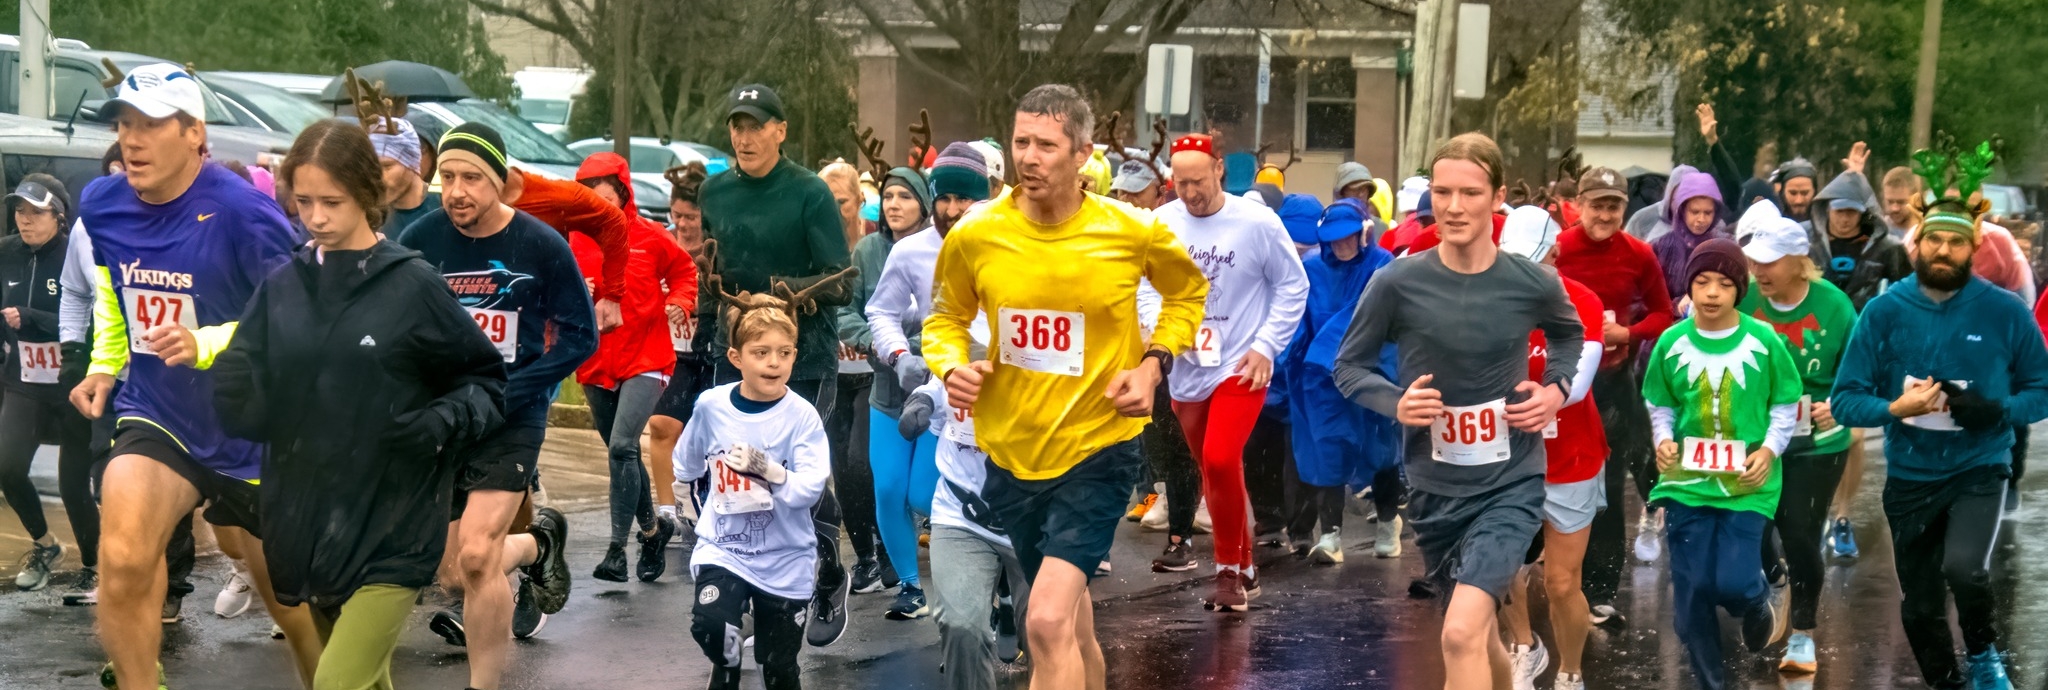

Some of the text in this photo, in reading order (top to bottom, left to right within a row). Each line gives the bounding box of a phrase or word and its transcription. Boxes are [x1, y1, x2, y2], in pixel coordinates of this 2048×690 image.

[1188, 245, 1235, 268] leighed
[136, 294, 183, 330] 427
[474, 312, 506, 343] 29
[1010, 314, 1071, 352] 368
[25, 345, 60, 369] 341
[1441, 407, 1496, 446] 369
[1693, 441, 1735, 472] 411
